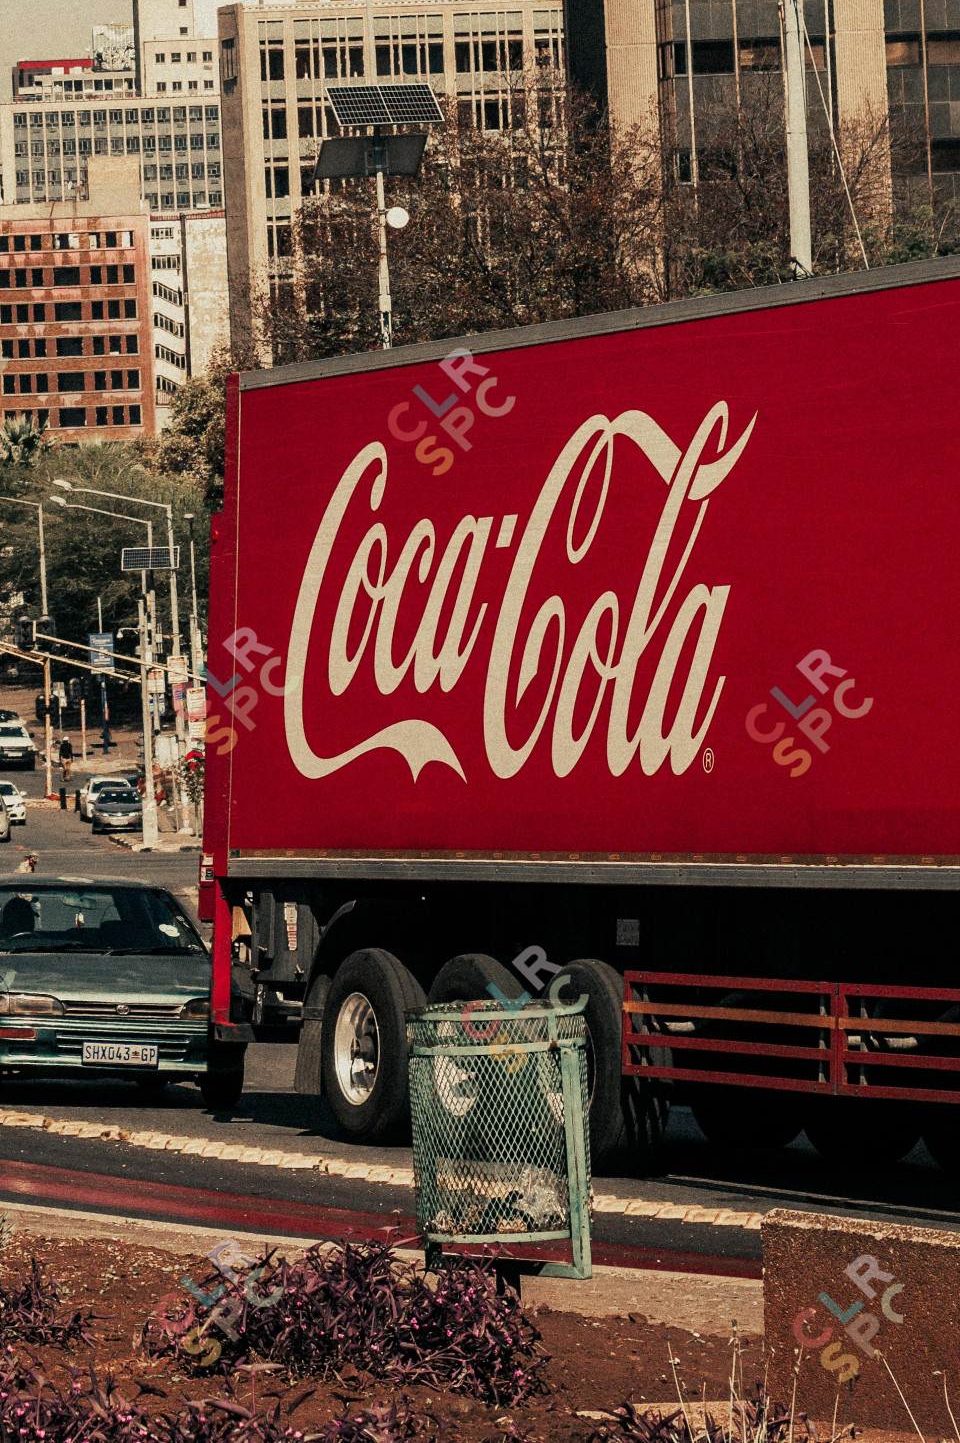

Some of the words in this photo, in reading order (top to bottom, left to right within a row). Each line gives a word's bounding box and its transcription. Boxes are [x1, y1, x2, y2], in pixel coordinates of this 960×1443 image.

[283, 400, 758, 784] Coca-Cola
[85, 1045, 130, 1061] SHX043
[141, 1047, 156, 1062] GP
